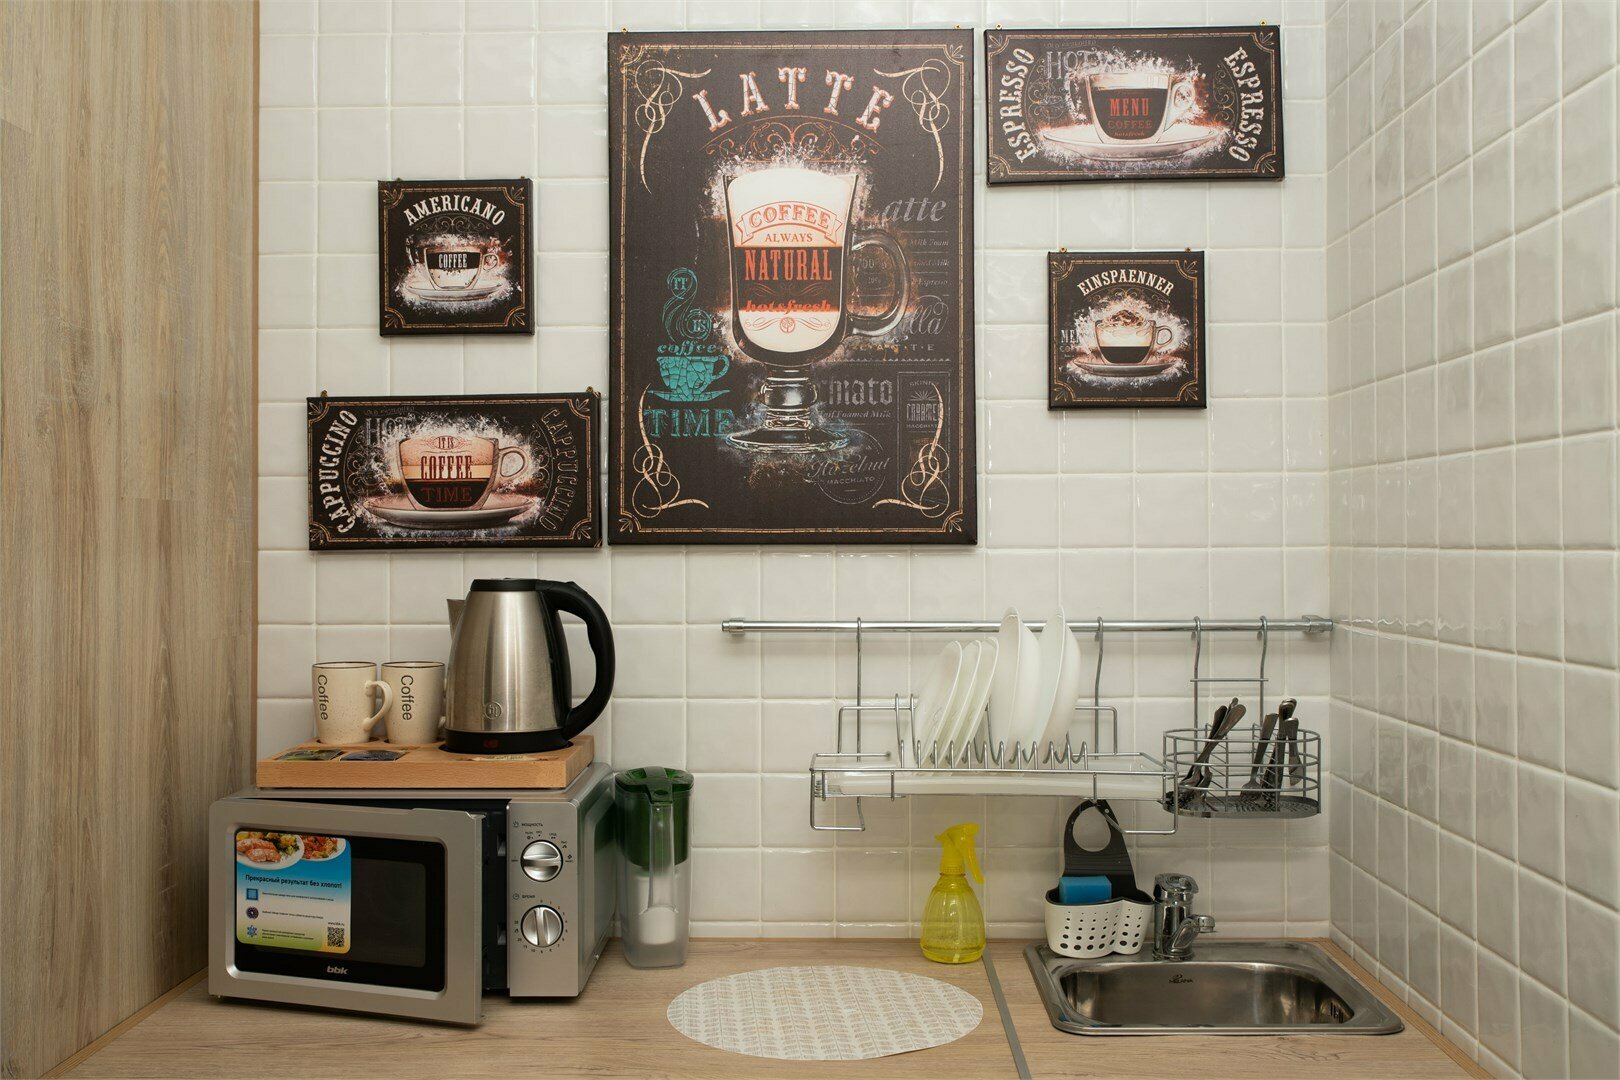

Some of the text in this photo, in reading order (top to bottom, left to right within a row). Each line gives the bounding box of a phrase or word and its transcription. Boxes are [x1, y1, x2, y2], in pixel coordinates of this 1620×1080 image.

[693, 66, 895, 133] LATTE
[999, 47, 1038, 163] ESPRESSO
[1109, 97, 1150, 117] MENU
[1223, 46, 1264, 163] ESPRESSO
[1107, 120, 1153, 130] COFFEE
[403, 194, 506, 226] AMERICANO
[748, 203, 832, 230] COFFEE
[881, 197, 947, 223] atte
[764, 233, 813, 243] ALWAYS
[438, 253, 468, 269] COFFEE
[744, 249, 832, 281] NATURAL
[673, 276, 688, 291] IT
[1076, 268, 1175, 297] EINSPAENNER
[692, 318, 709, 334] IS
[657, 340, 717, 356] coffee
[644, 408, 735, 438] TIME
[318, 409, 359, 534] CAPPUCCINO
[420, 455, 473, 481] COFFEE
[538, 406, 580, 533] CAPPUCCINO
[421, 486, 473, 503] TIME
[317, 674, 330, 721] Coffee
[400, 674, 415, 721] Coffee
[245, 874, 280, 883] Прекрасный
[281, 878, 309, 886] результат
[309, 879, 320, 887] без
[326, 965, 348, 975] bbk
